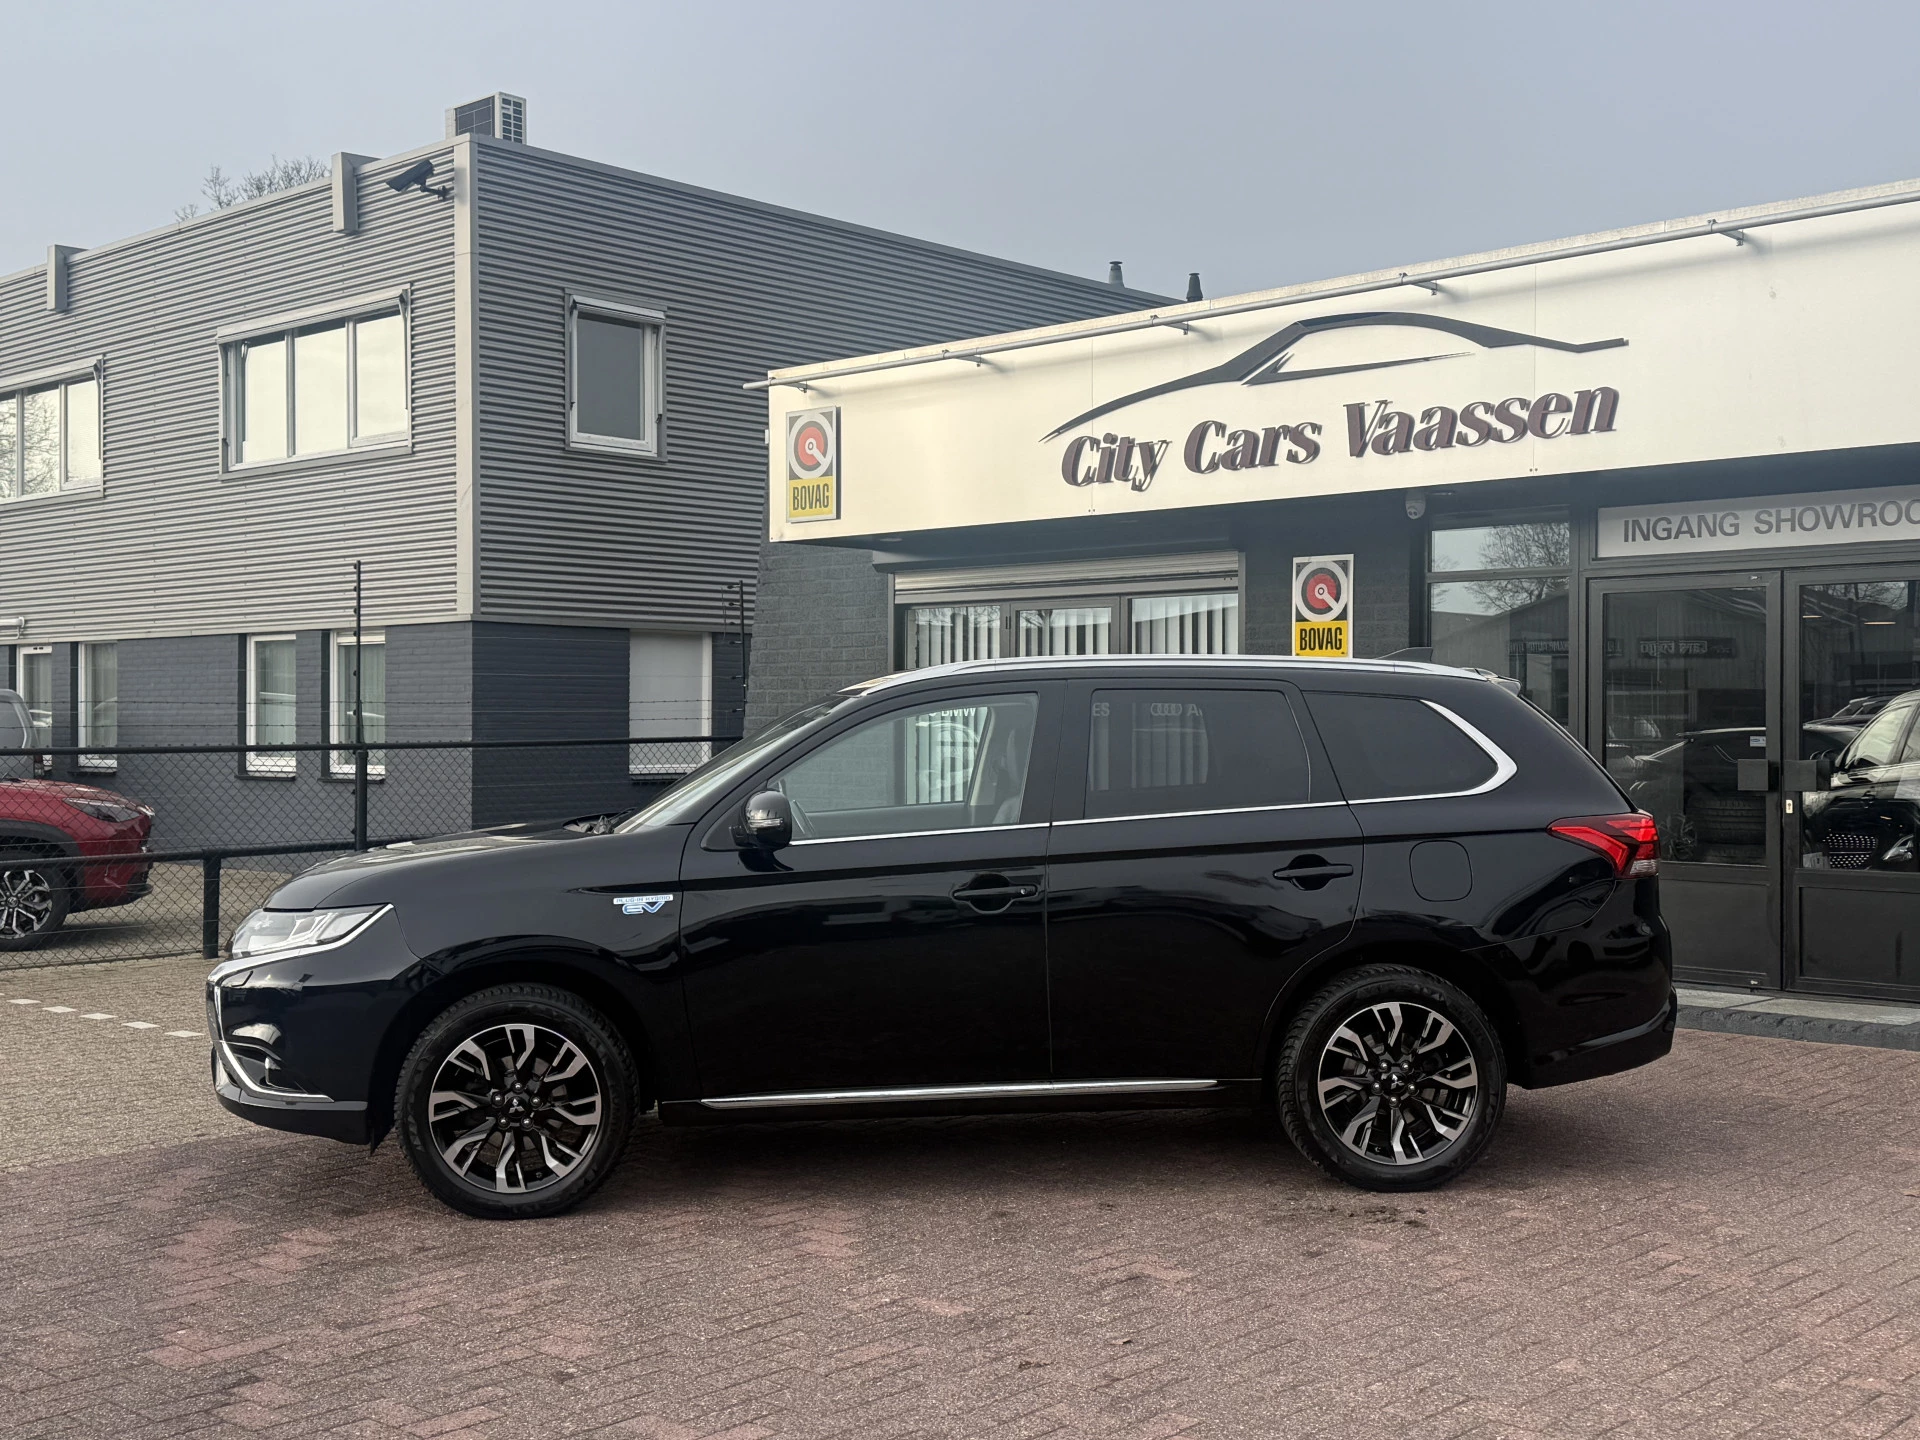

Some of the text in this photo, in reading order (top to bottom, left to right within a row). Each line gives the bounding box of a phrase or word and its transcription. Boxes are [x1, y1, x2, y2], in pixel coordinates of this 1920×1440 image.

[1061, 383, 1620, 492] City Cars Vaassen
[792, 483, 830, 511] BOVAG
[1623, 512, 1740, 543] INGANG
[1299, 626, 1343, 651] BOVAG
[622, 901, 666, 915] EV
